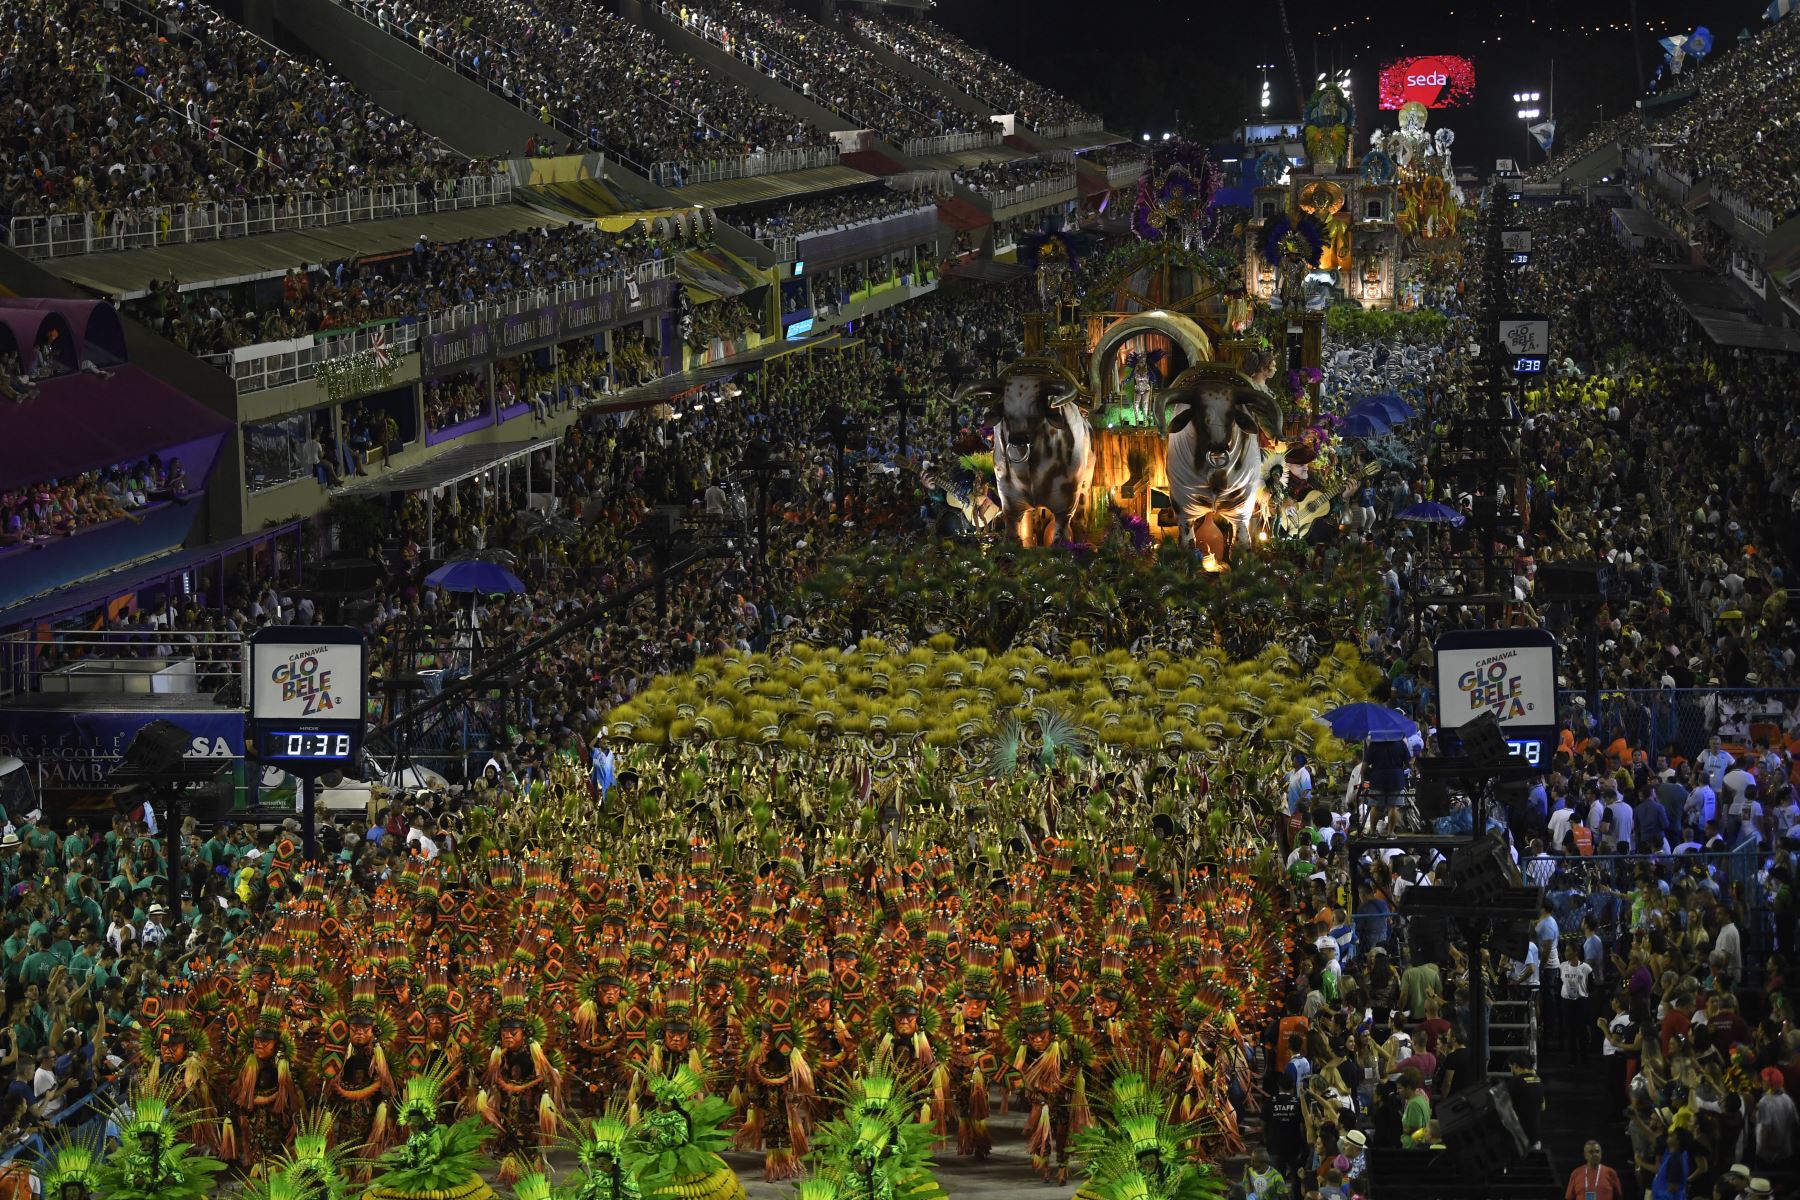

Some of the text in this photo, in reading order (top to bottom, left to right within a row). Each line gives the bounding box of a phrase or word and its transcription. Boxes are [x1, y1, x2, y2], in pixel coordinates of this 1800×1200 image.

[1407, 71, 1446, 86] seda
[1507, 326, 1529, 338] GLO
[289, 645, 328, 661] CARNAVAL
[1475, 649, 1518, 667] CARNAVAL
[272, 656, 319, 684] GLO
[1458, 661, 1507, 692] GLO
[282, 670, 332, 701] BELE
[1470, 675, 1522, 710] BELE
[302, 690, 333, 716] ZA
[1491, 696, 1526, 722] ZA
[0, 734, 120, 747] DESFILE
[287, 734, 350, 756] 0:38
[41, 748, 120, 763] ESCOLAS
[1273, 1104, 1295, 1112] STAFF
